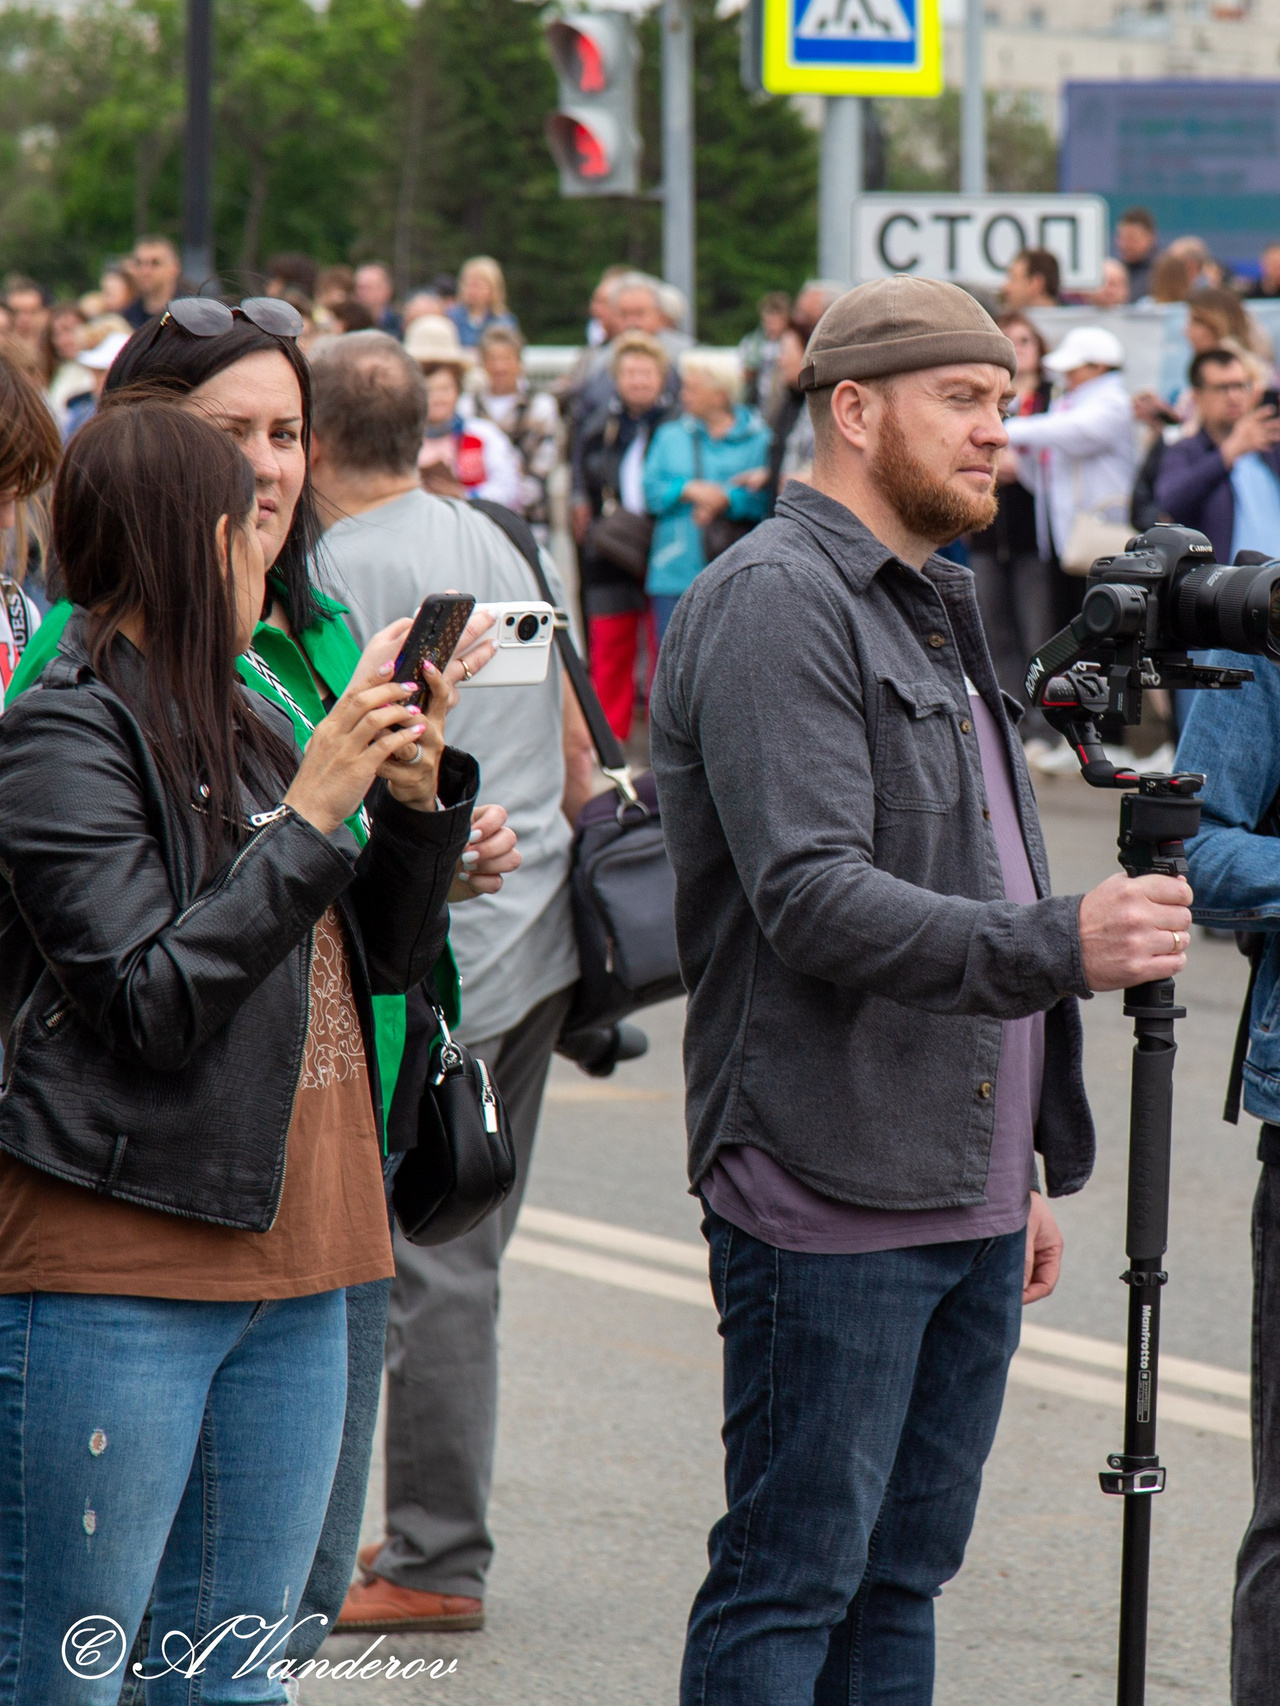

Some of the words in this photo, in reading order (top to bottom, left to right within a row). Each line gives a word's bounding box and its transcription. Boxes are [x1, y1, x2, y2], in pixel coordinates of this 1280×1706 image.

[876, 213, 1079, 273] СТОП
[1189, 543, 1213, 553] Canon
[1140, 1305, 1152, 1369] Manfrotto
